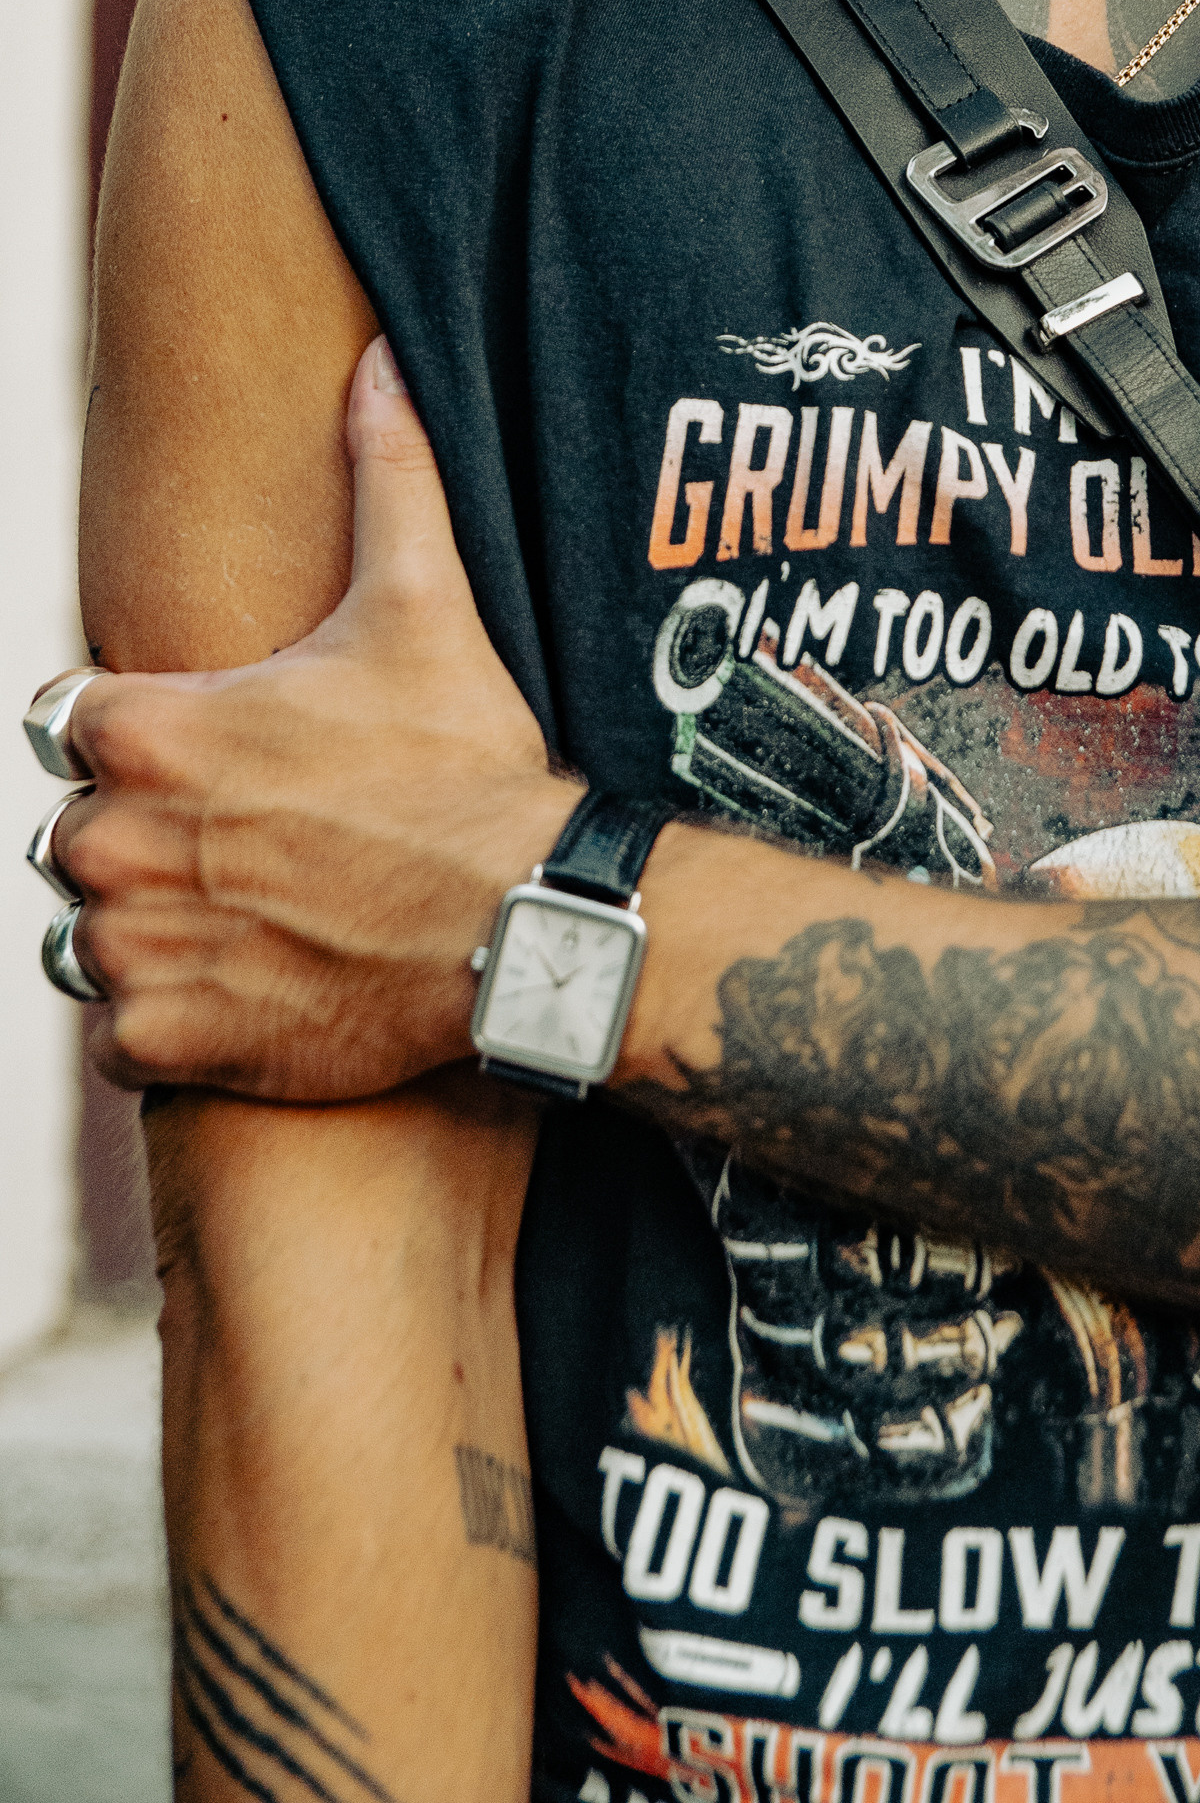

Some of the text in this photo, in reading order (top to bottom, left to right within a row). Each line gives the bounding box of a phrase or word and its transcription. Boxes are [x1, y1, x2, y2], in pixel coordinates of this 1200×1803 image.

[647, 397, 1037, 571] GRUMPY
[738, 560, 861, 666] I'M
[872, 587, 992, 684] TOO
[1009, 607, 1144, 695] OLD
[598, 1446, 770, 1617] TOO
[798, 1515, 1127, 1635] SLOW
[817, 1641, 987, 1746] I'LL
